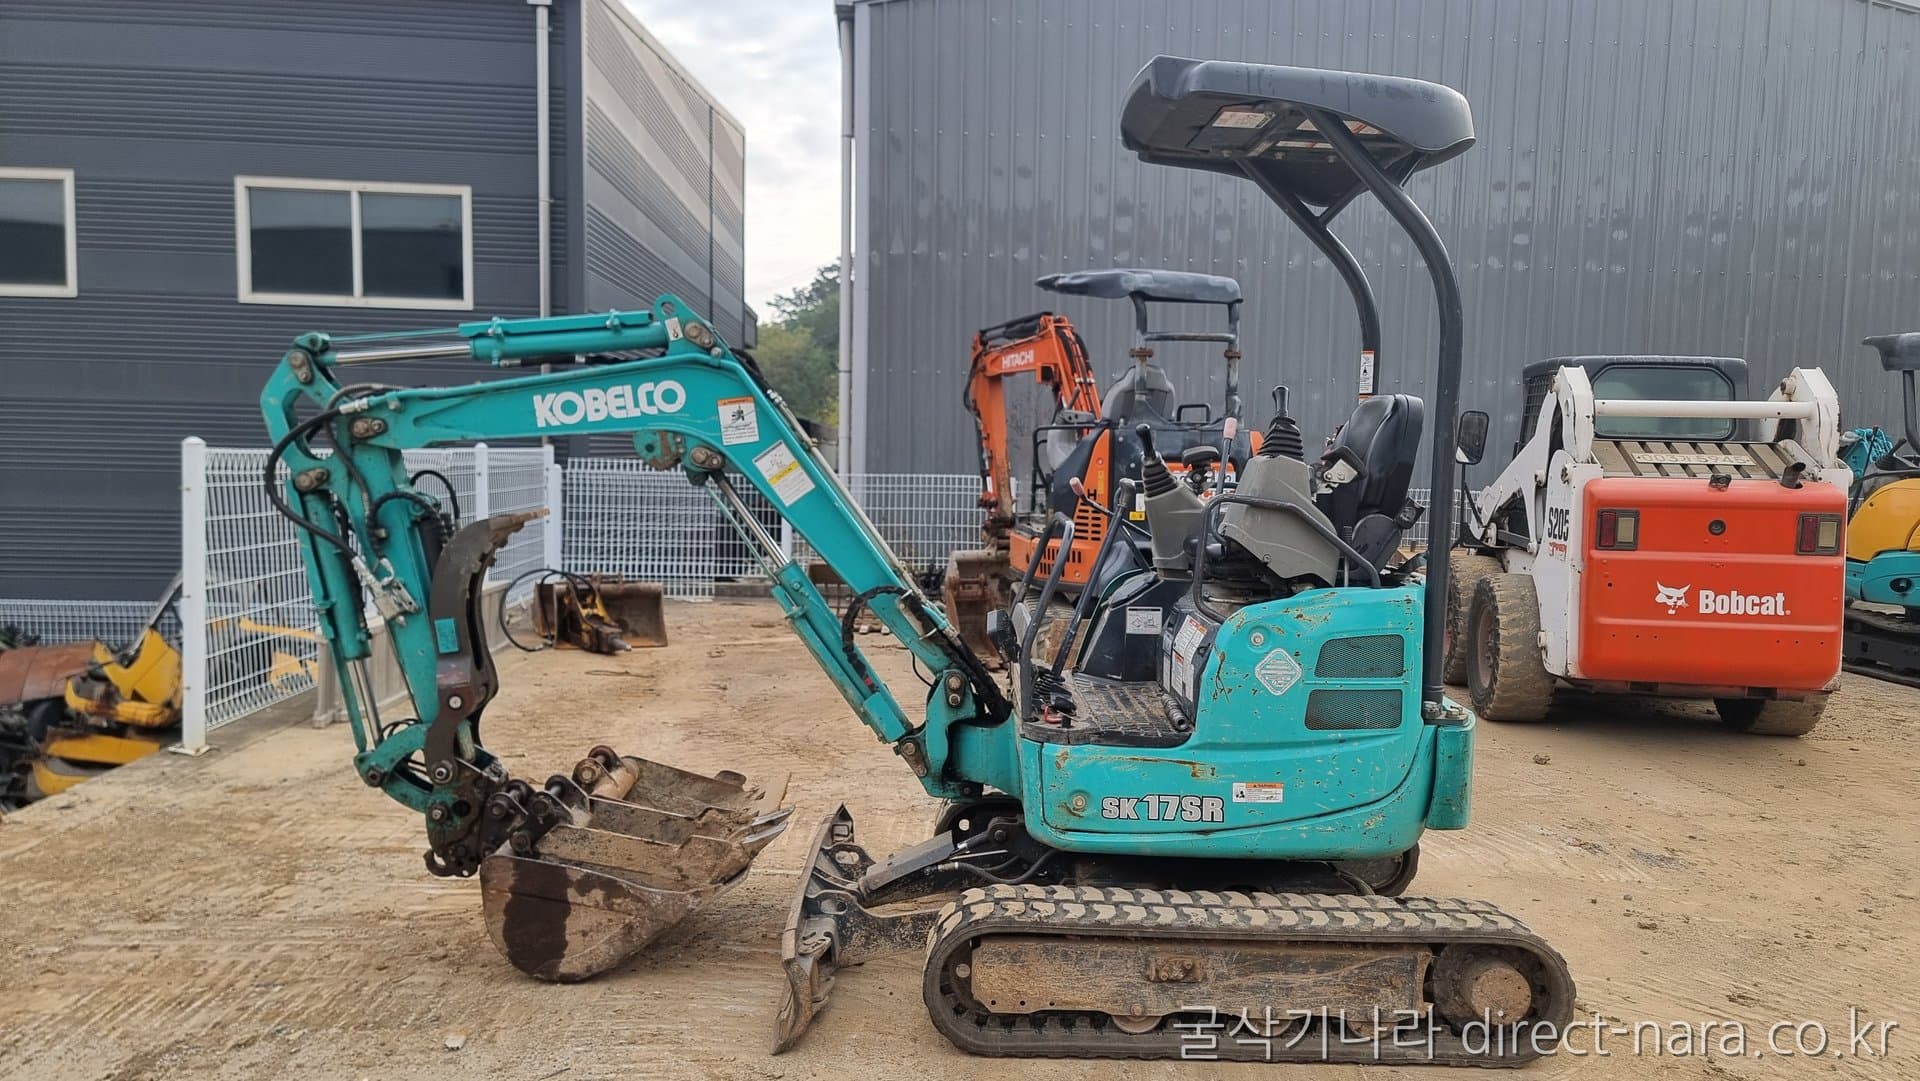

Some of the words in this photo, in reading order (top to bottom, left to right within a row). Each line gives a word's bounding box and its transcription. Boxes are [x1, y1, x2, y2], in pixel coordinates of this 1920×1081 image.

[1002, 350, 1035, 369] HITACHI
[533, 380, 686, 428] KOBELCO
[1548, 506, 1570, 541] S205
[1699, 589, 1785, 616] Bobcat
